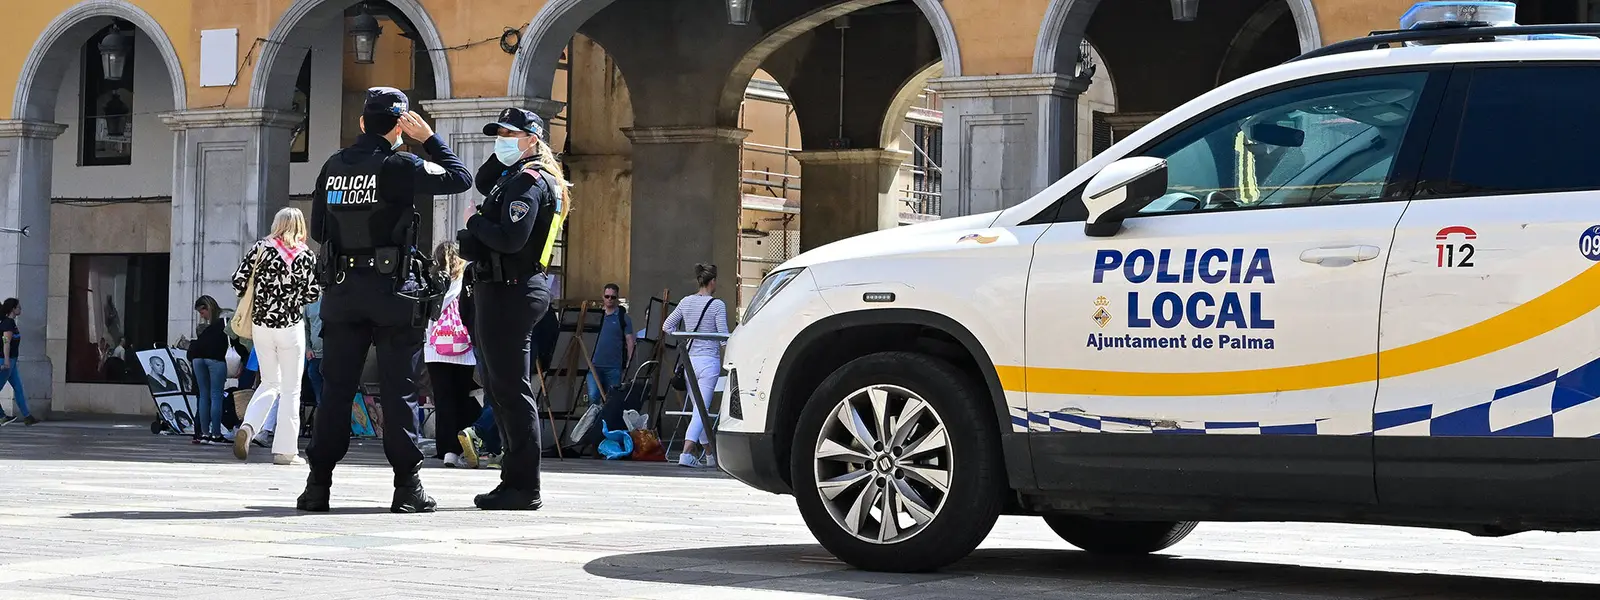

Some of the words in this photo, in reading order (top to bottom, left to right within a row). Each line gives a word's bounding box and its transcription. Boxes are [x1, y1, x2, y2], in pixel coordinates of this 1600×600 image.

[325, 174, 377, 191] POLICIA
[342, 189, 378, 204] LOCAL
[1092, 248, 1276, 284] POLICIA
[1436, 243, 1475, 268] 112
[1127, 291, 1275, 330] LOCAL
[1086, 333, 1187, 351] Ajuntament
[1192, 334, 1214, 349] de
[1219, 334, 1275, 350] Palma
